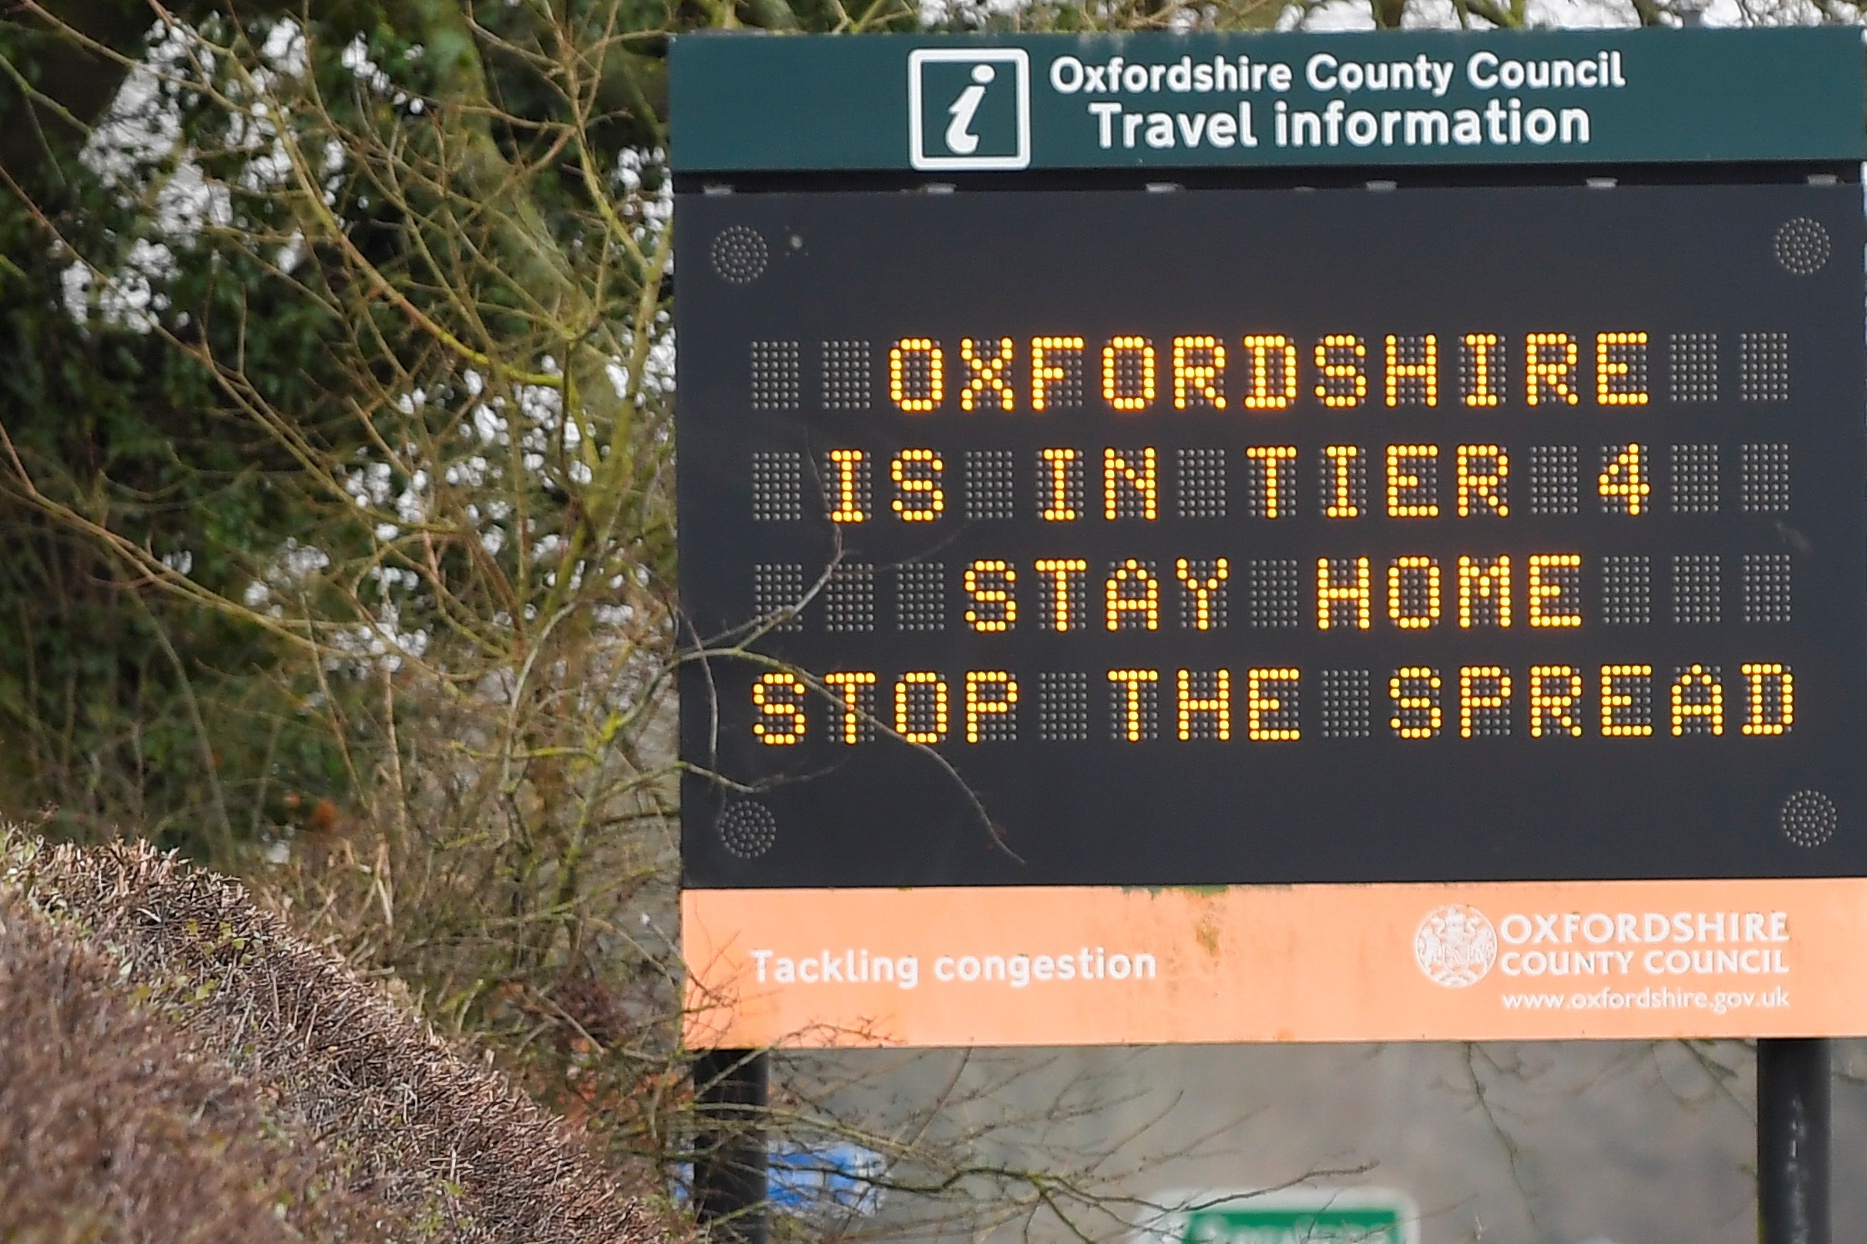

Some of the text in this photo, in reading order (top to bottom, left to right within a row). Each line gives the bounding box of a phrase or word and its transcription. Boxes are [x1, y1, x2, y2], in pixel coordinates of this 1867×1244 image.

[1050, 51, 1626, 96] Oxfordshire County Council
[1088, 98, 1590, 148] Travel information
[889, 332, 1649, 412] OXFORDSHIRE
[830, 443, 1650, 523] IS IN TIER 4
[964, 554, 1581, 632] STAY HOME
[753, 663, 1793, 745] STOP THE SPREAD
[1500, 911, 1790, 944] OXFORDSHIRE
[751, 947, 1157, 988] Tackling congestion
[1501, 949, 1790, 976] COUNTY COUNCIL
[1502, 986, 1790, 1014] www.oxfordshire.gov.uk
